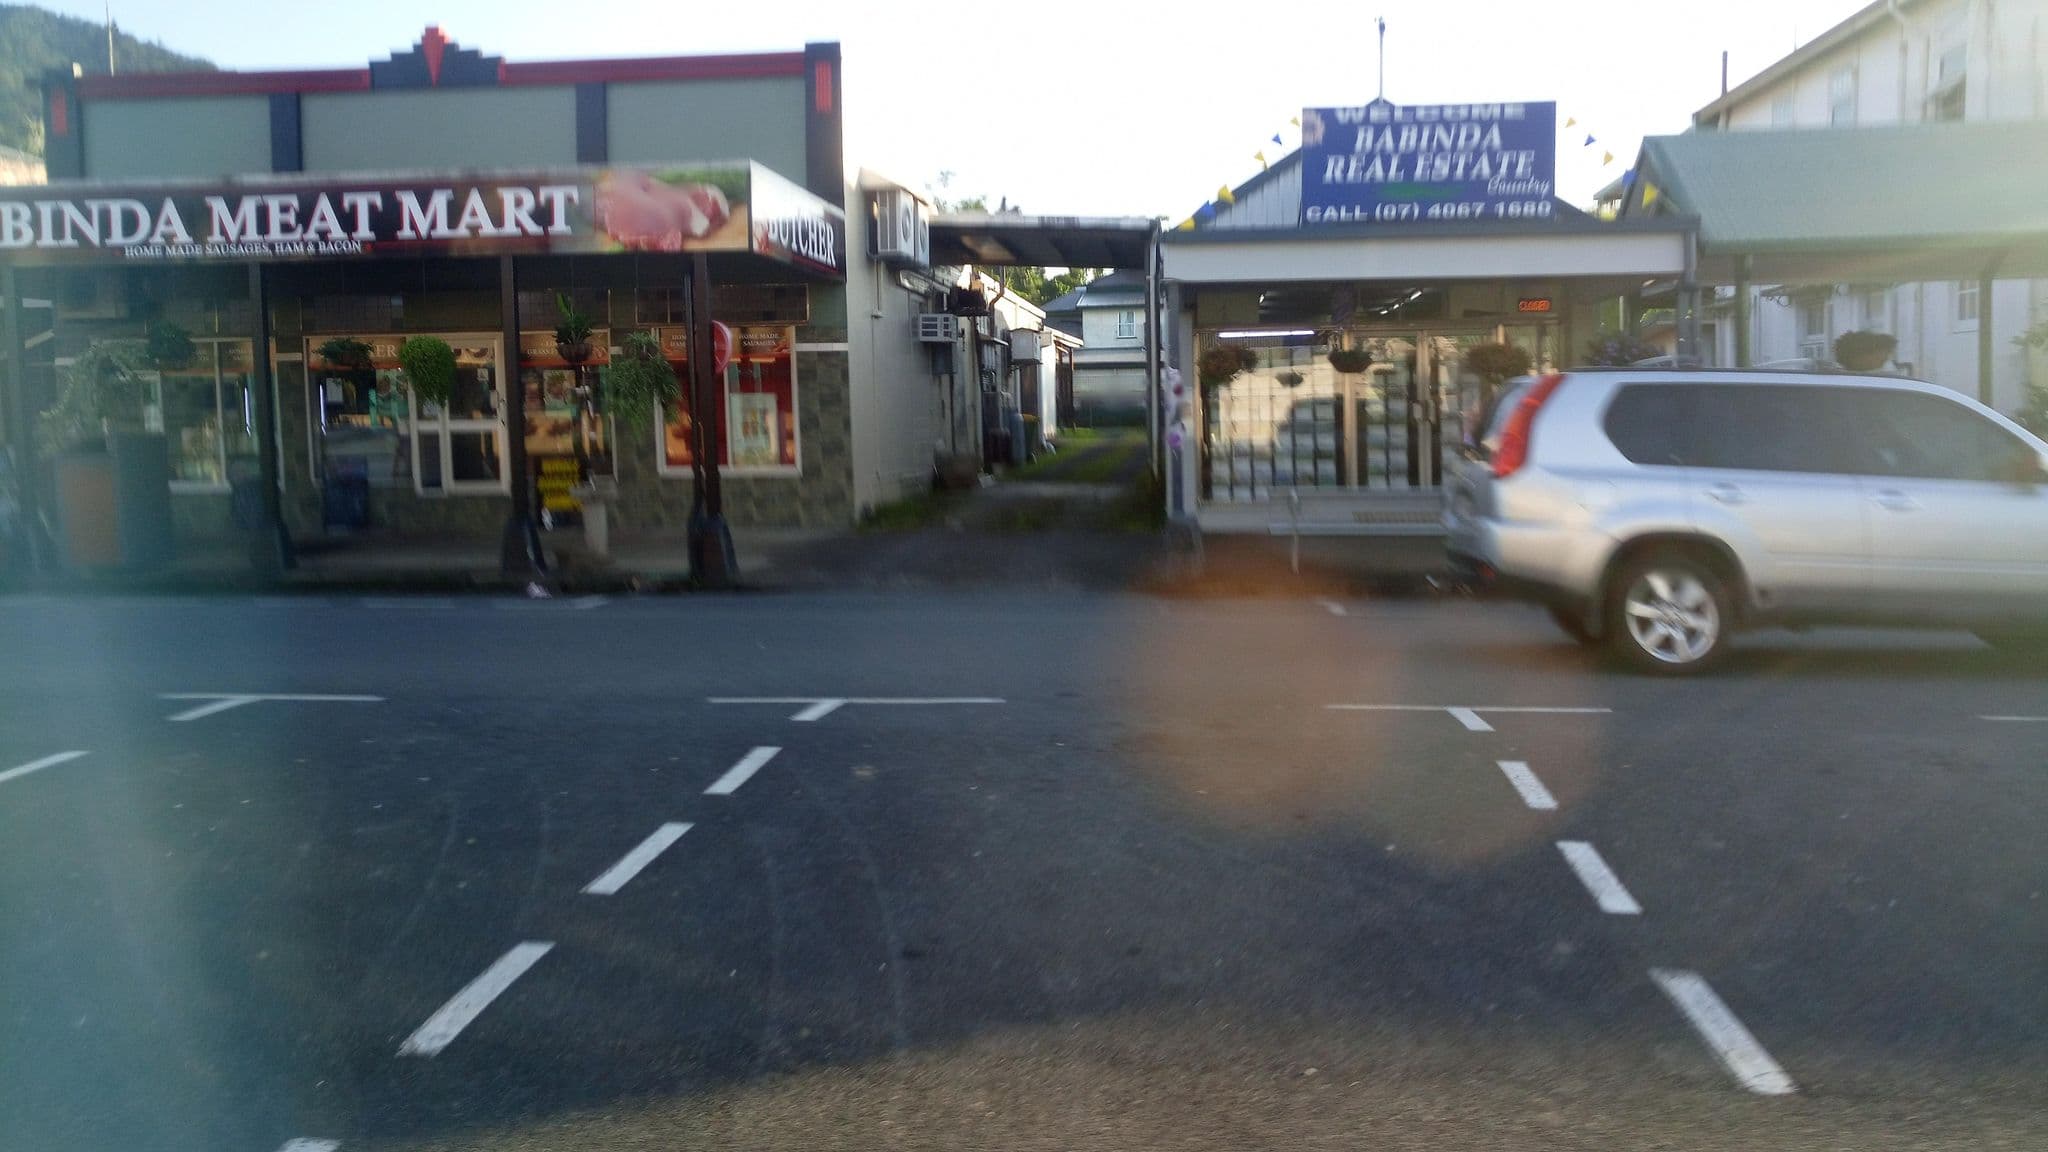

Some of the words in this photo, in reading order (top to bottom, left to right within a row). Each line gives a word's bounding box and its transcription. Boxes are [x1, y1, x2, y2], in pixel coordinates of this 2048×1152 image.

[1354, 122, 1503, 153] BABINDA
[1323, 153, 1404, 184] REAL
[1414, 150, 1535, 182] ESTATE
[205, 191, 384, 243] MEAT
[396, 185, 579, 239] MART
[1306, 204, 1368, 222] CALL
[1374, 203, 1420, 221] (07)
[125, 244, 161, 256] HOME
[165, 243, 201, 255] MADE
[205, 242, 271, 255] SAUSAGES,
[274, 241, 304, 254] HAM
[306, 242, 315, 253] &
[318, 240, 361, 253] BACON
[768, 214, 836, 268] BUTCHER
